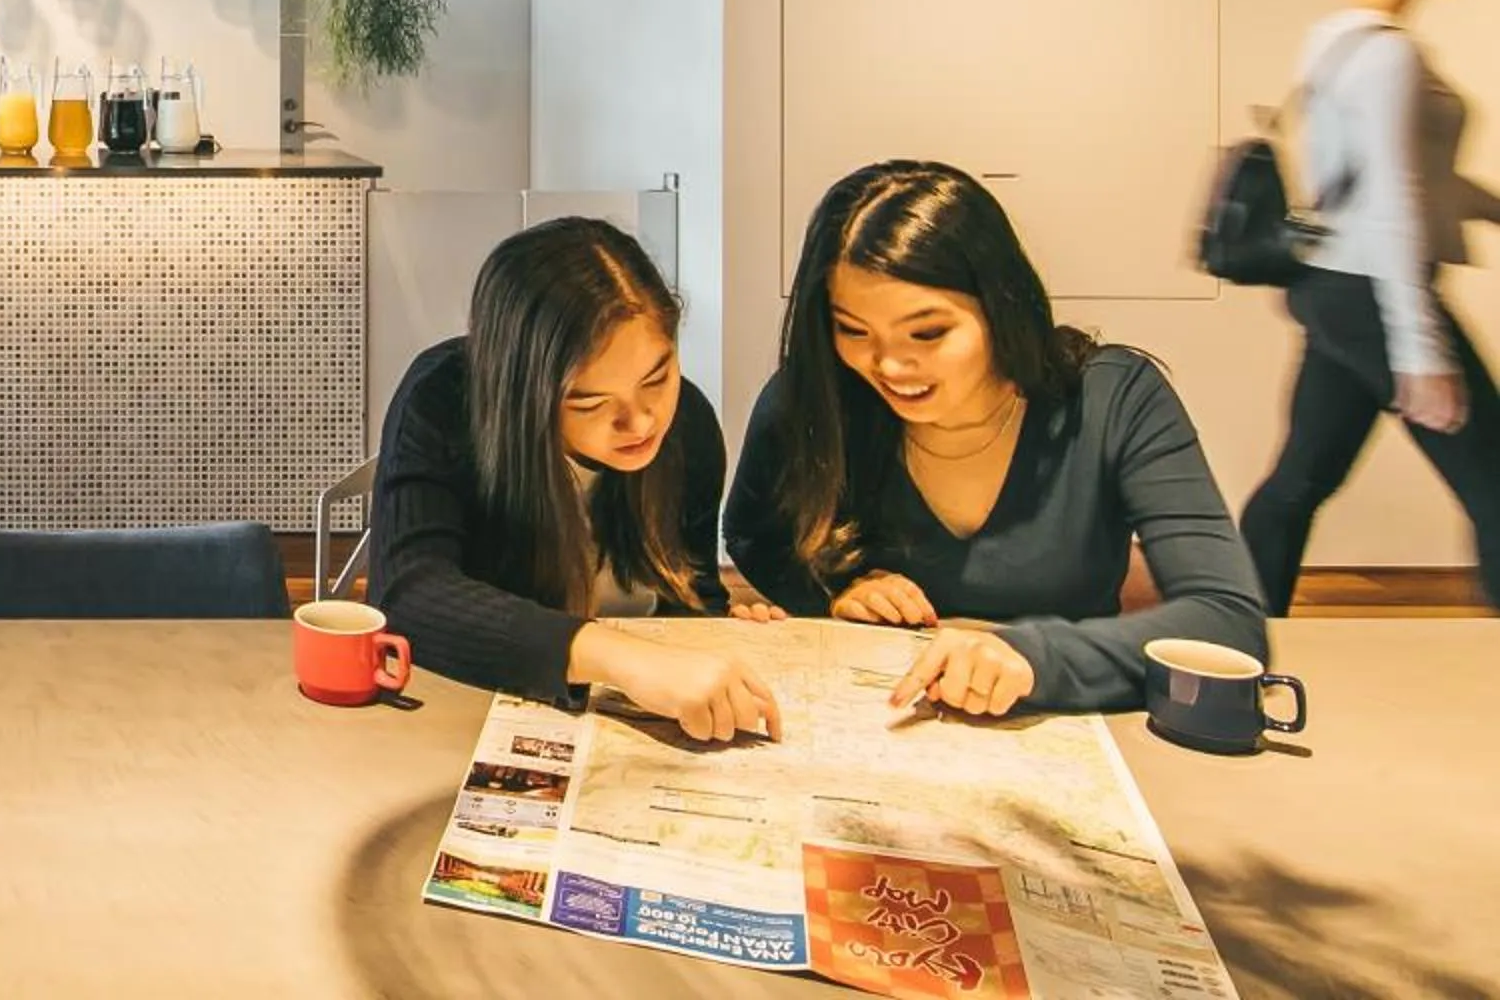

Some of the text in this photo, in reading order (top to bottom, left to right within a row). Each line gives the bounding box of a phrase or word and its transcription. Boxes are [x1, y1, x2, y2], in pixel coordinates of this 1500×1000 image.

[860, 875, 951, 914] Map
[864, 906, 960, 947] City
[723, 933, 795, 950] JAPAN
[747, 946, 795, 961] ANA
